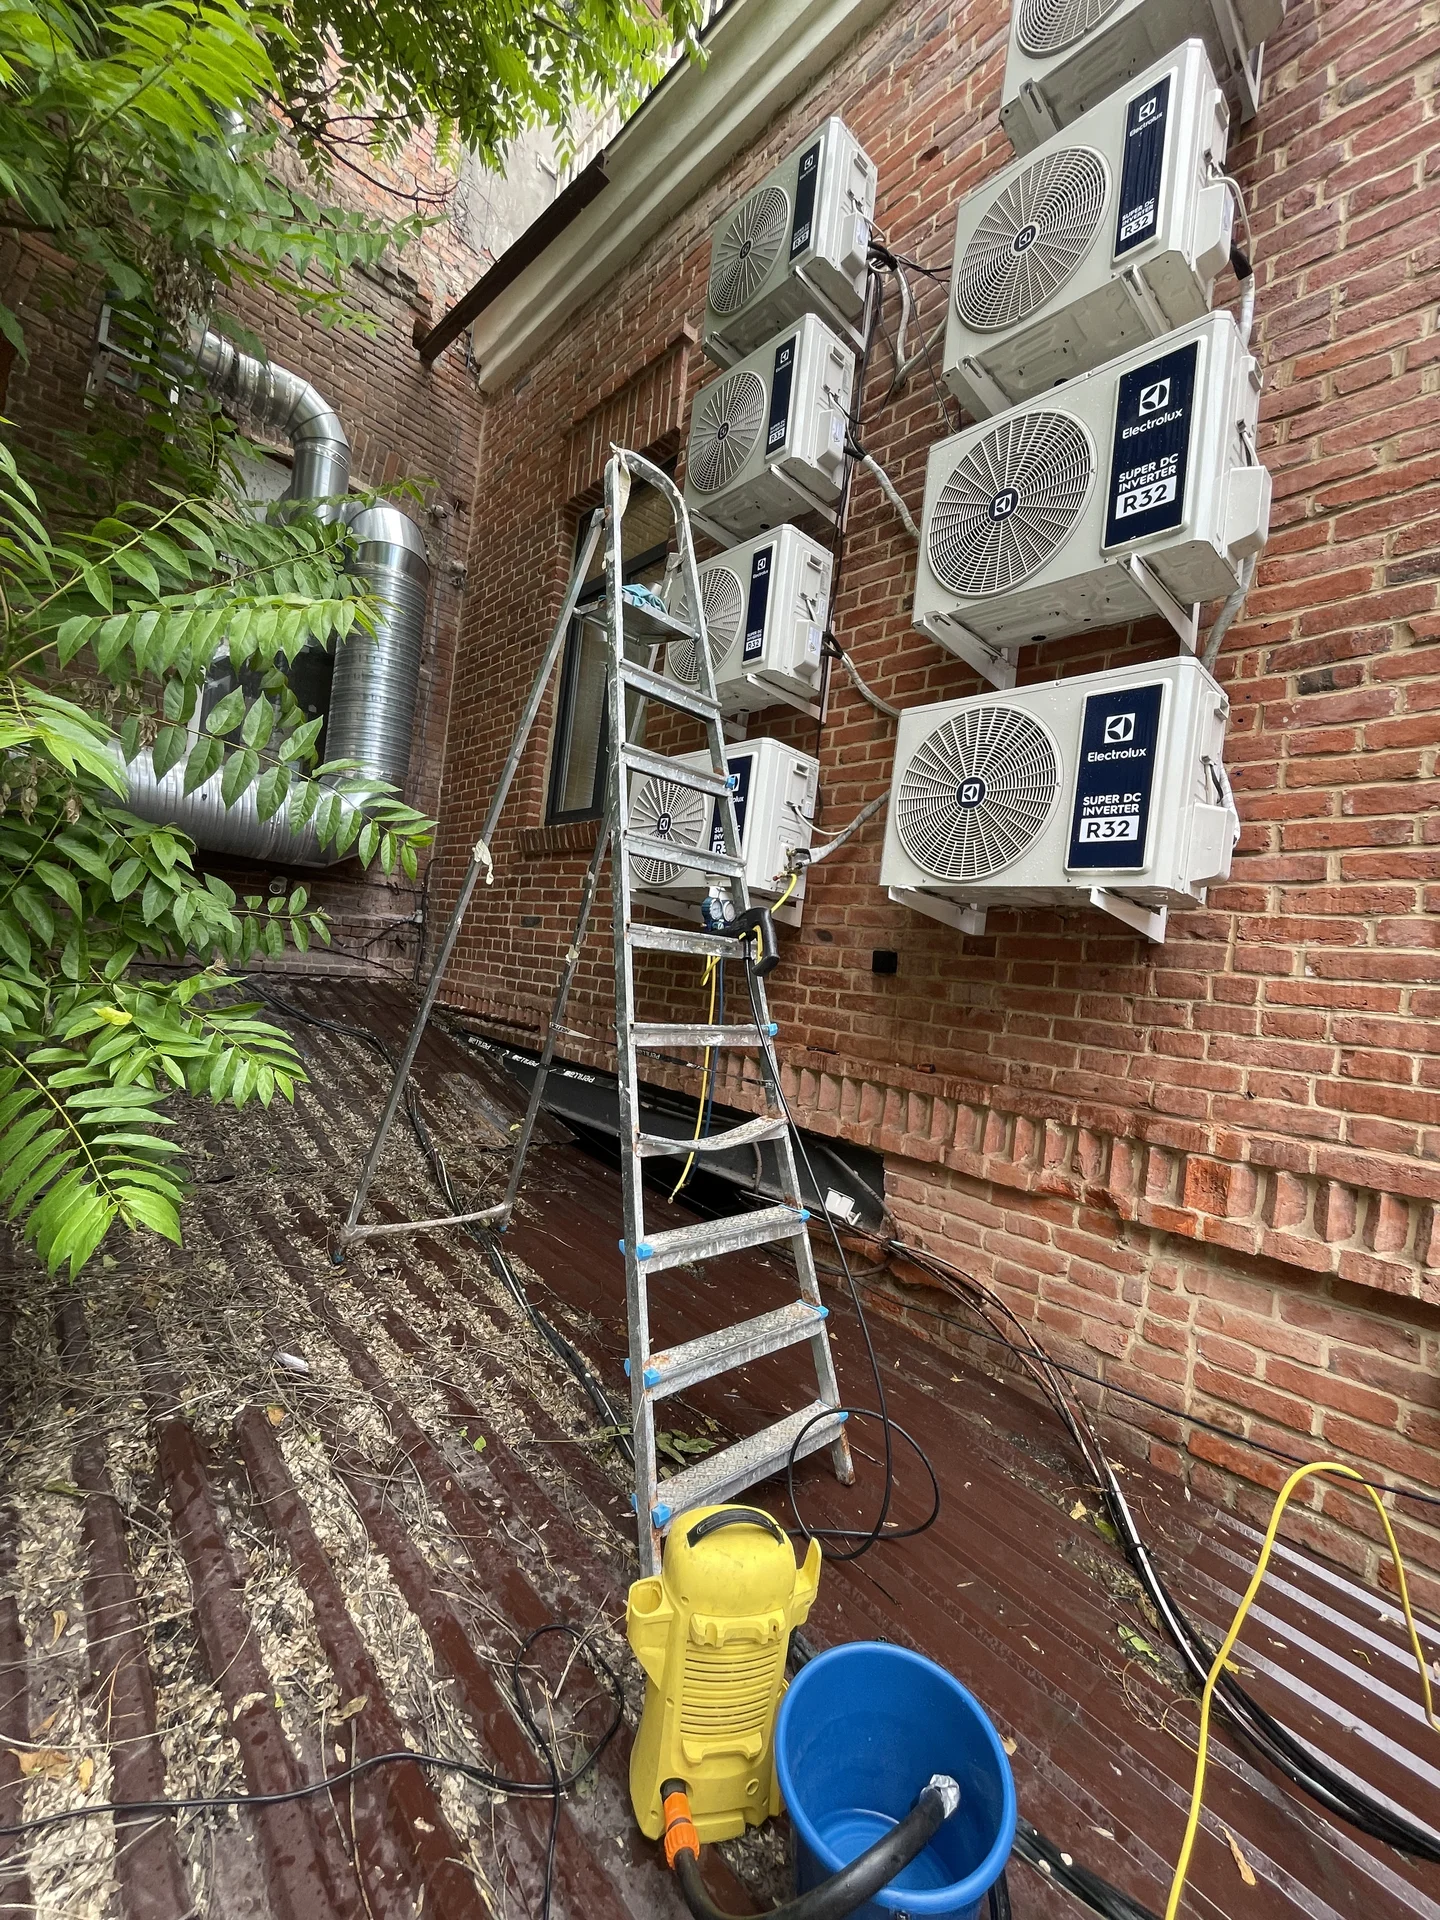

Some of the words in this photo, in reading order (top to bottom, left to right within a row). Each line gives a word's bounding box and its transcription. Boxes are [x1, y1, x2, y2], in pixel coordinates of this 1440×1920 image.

[1129, 112, 1163, 137] Electrolux
[1121, 204, 1154, 227] INVERTER
[1122, 204, 1143, 221] SUPER
[1144, 198, 1155, 208] DC
[1124, 215, 1149, 237] R32
[1122, 408, 1183, 440] Electrolux
[1119, 462, 1156, 483] SUPER
[1160, 453, 1179, 468] DC
[1119, 465, 1177, 493] INVERTER
[1123, 484, 1168, 514] R32
[747, 640, 760, 650] R32
[1087, 748, 1147, 762] Electrolux
[1083, 794, 1120, 805] SUPER
[1123, 792, 1141, 802] DC
[1083, 803, 1139, 816] INVERTER
[1086, 820, 1130, 839] R32
